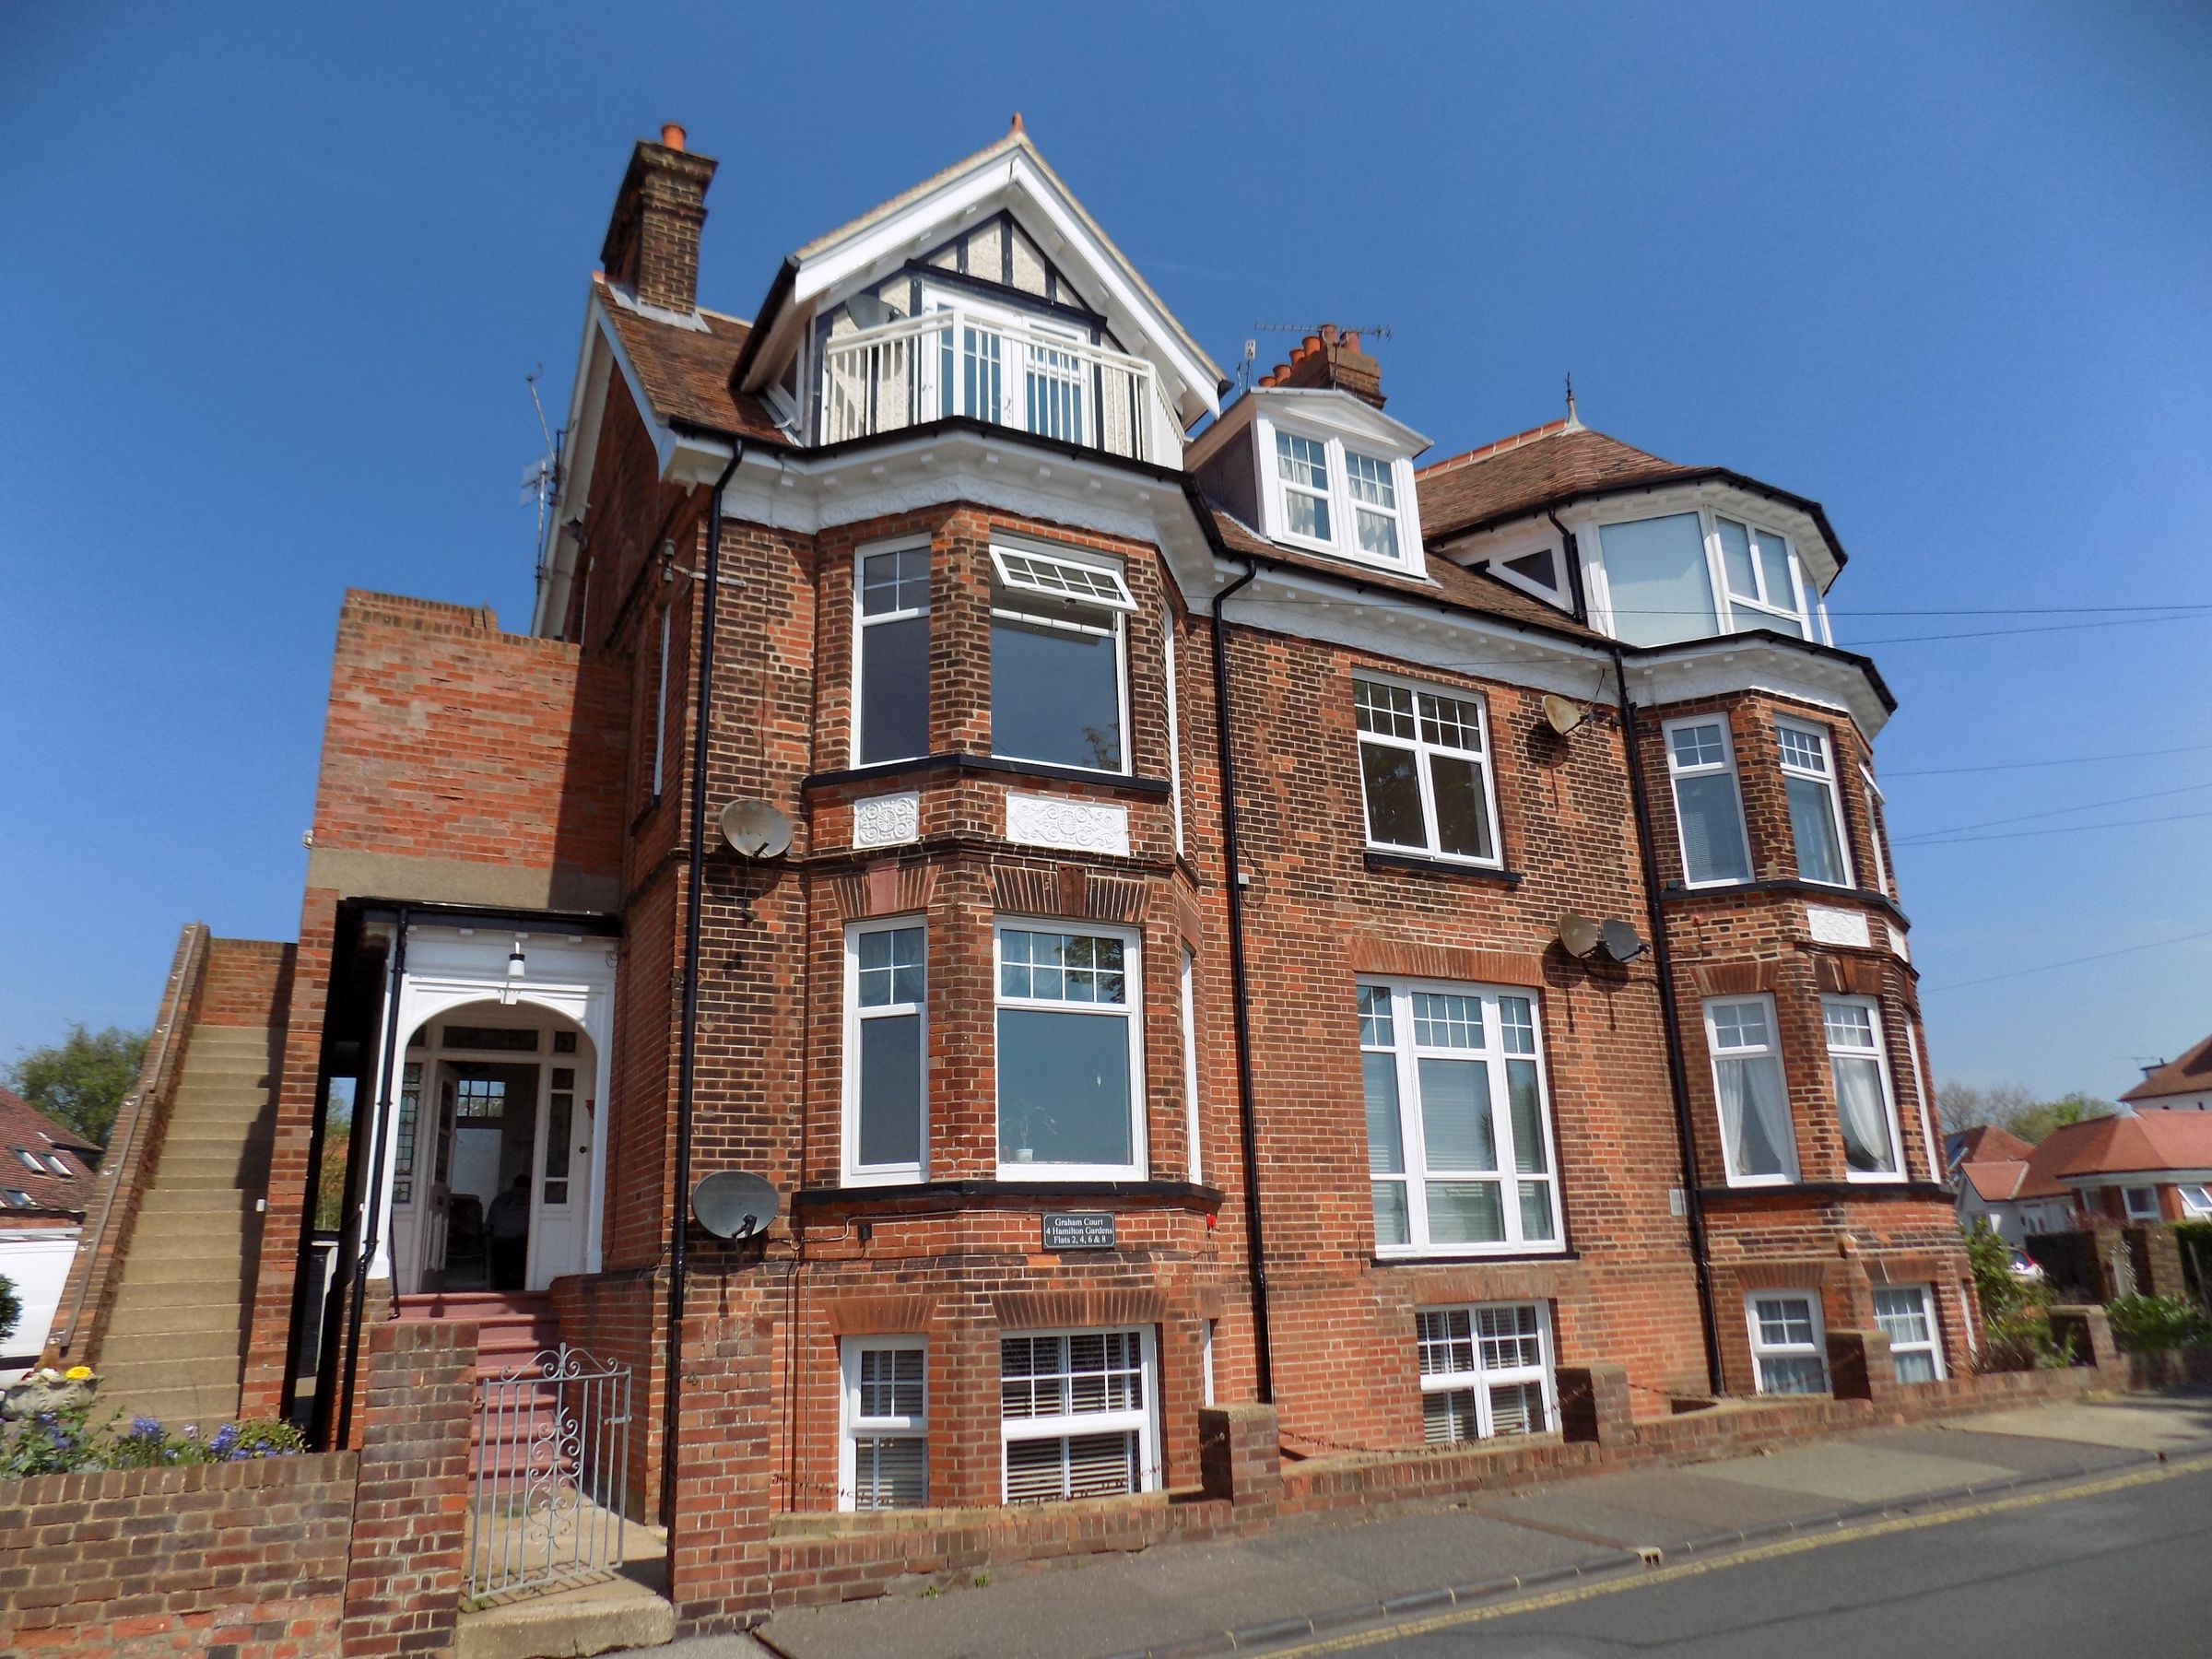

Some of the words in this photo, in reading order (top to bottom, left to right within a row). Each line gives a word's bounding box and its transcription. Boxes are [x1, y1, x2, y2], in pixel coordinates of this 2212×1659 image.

[1054, 1218, 1082, 1226] Graham
[1083, 1218, 1103, 1226] Court
[1053, 1227, 1084, 1235] Hamilton
[1053, 1236, 1070, 1244] Flats
[1071, 1236, 1078, 1244] 2,
[1079, 1236, 1087, 1244] 4,
[1088, 1235, 1093, 1243] 6
[1094, 1235, 1100, 1243] &
